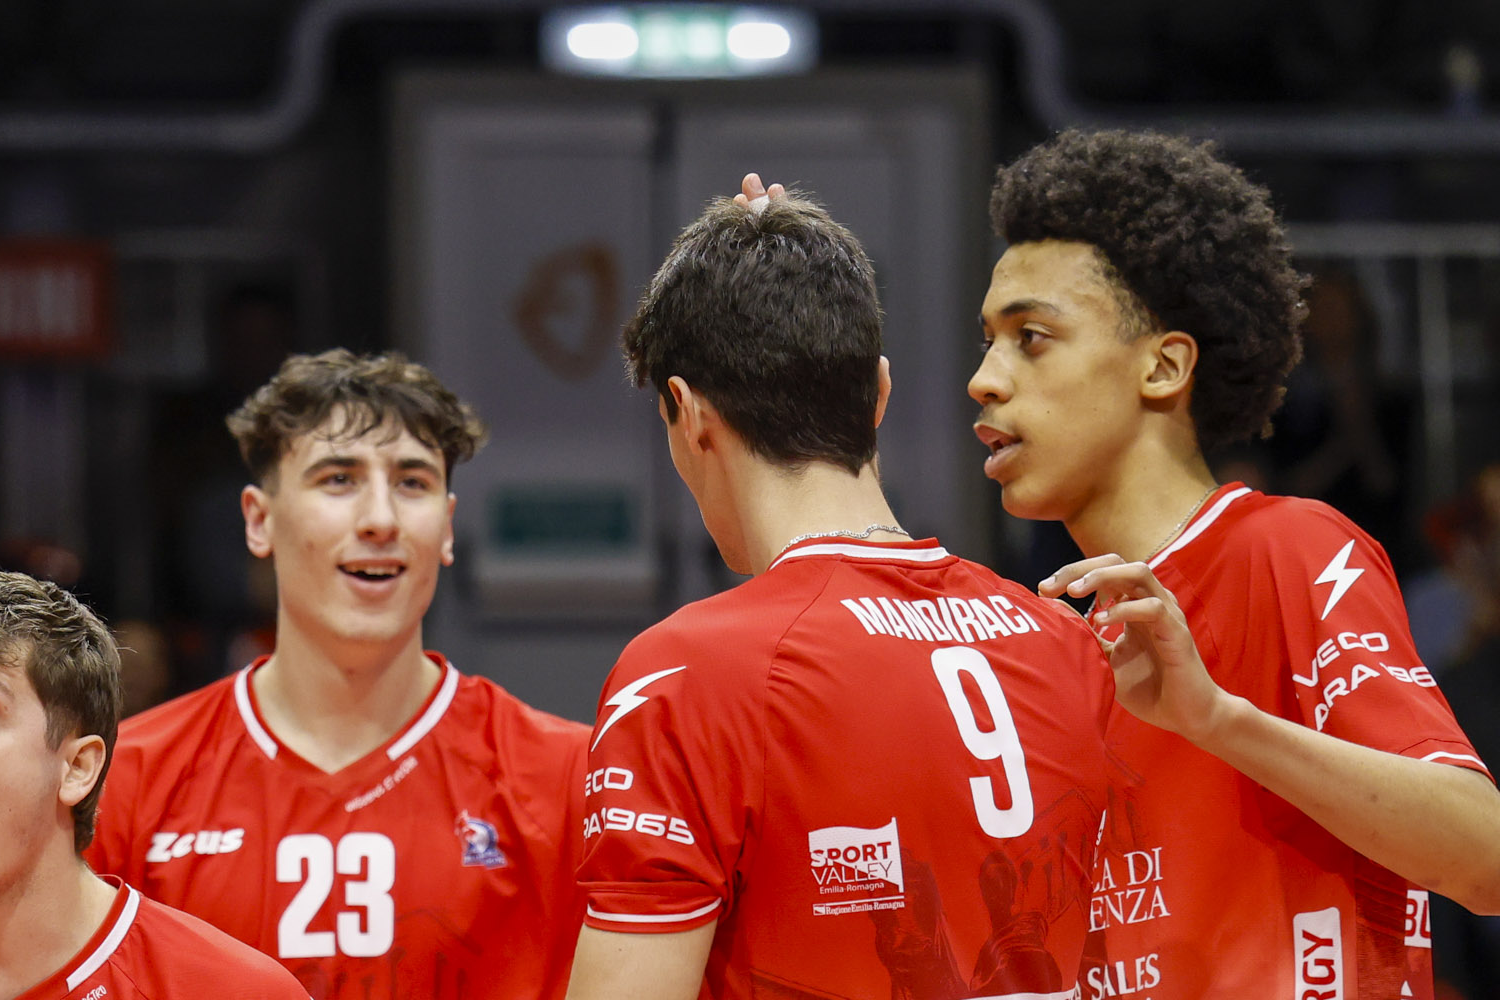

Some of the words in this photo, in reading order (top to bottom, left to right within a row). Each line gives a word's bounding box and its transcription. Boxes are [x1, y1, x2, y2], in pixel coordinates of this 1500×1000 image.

[930, 645, 1035, 839] 9
[146, 827, 246, 862] Zeus
[810, 841, 892, 868] SPORT
[811, 860, 893, 886] VALLEY
[1123, 846, 1164, 886] DI
[276, 831, 396, 959] 23
